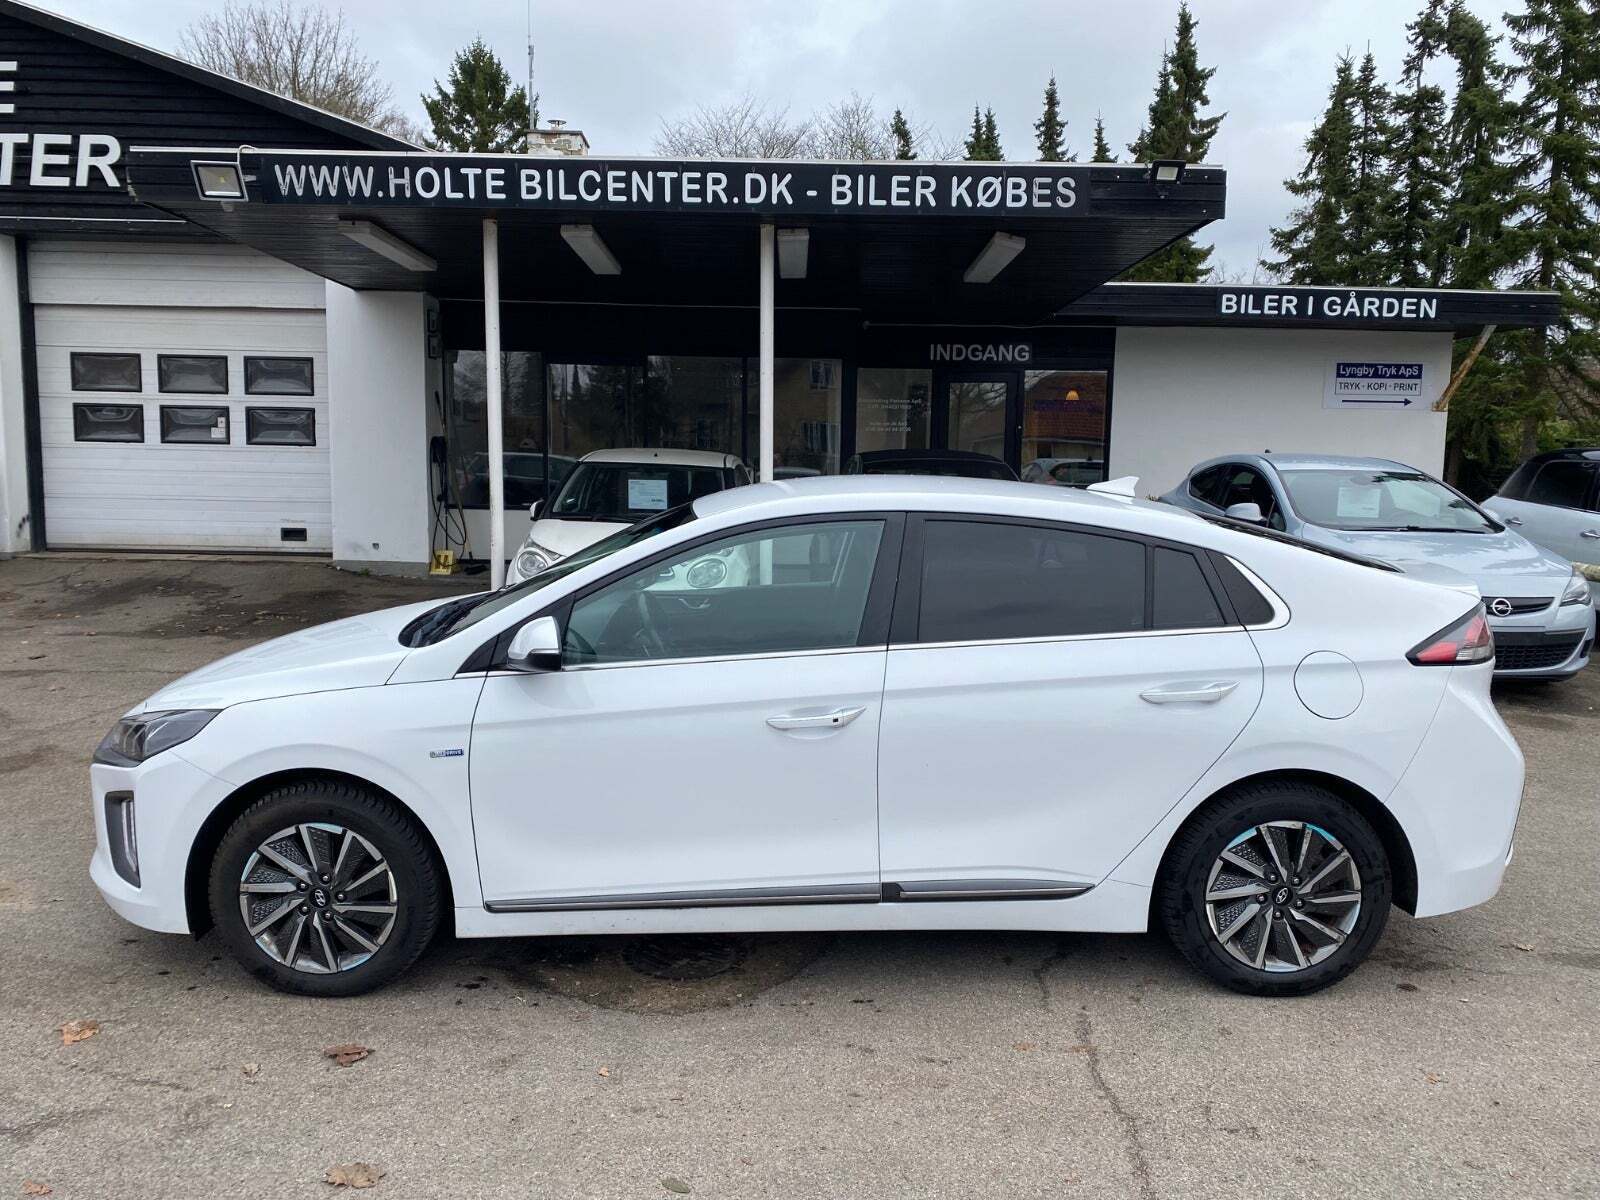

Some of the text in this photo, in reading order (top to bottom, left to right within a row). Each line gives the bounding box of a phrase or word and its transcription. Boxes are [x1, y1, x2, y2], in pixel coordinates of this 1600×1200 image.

[0, 132, 122, 188] TER
[274, 163, 507, 200] WWW.HOLTE
[520, 167, 793, 206] BILCENTER.DK
[831, 173, 937, 208] BILER
[951, 175, 1077, 209] KØBES
[1221, 291, 1437, 319] BILER I GÅRDEN
[930, 343, 1031, 362] INDGANG
[1340, 364, 1419, 378] Lyngby Tryk ApS
[1339, 381, 1419, 392] TRYK KOPI PRINT
